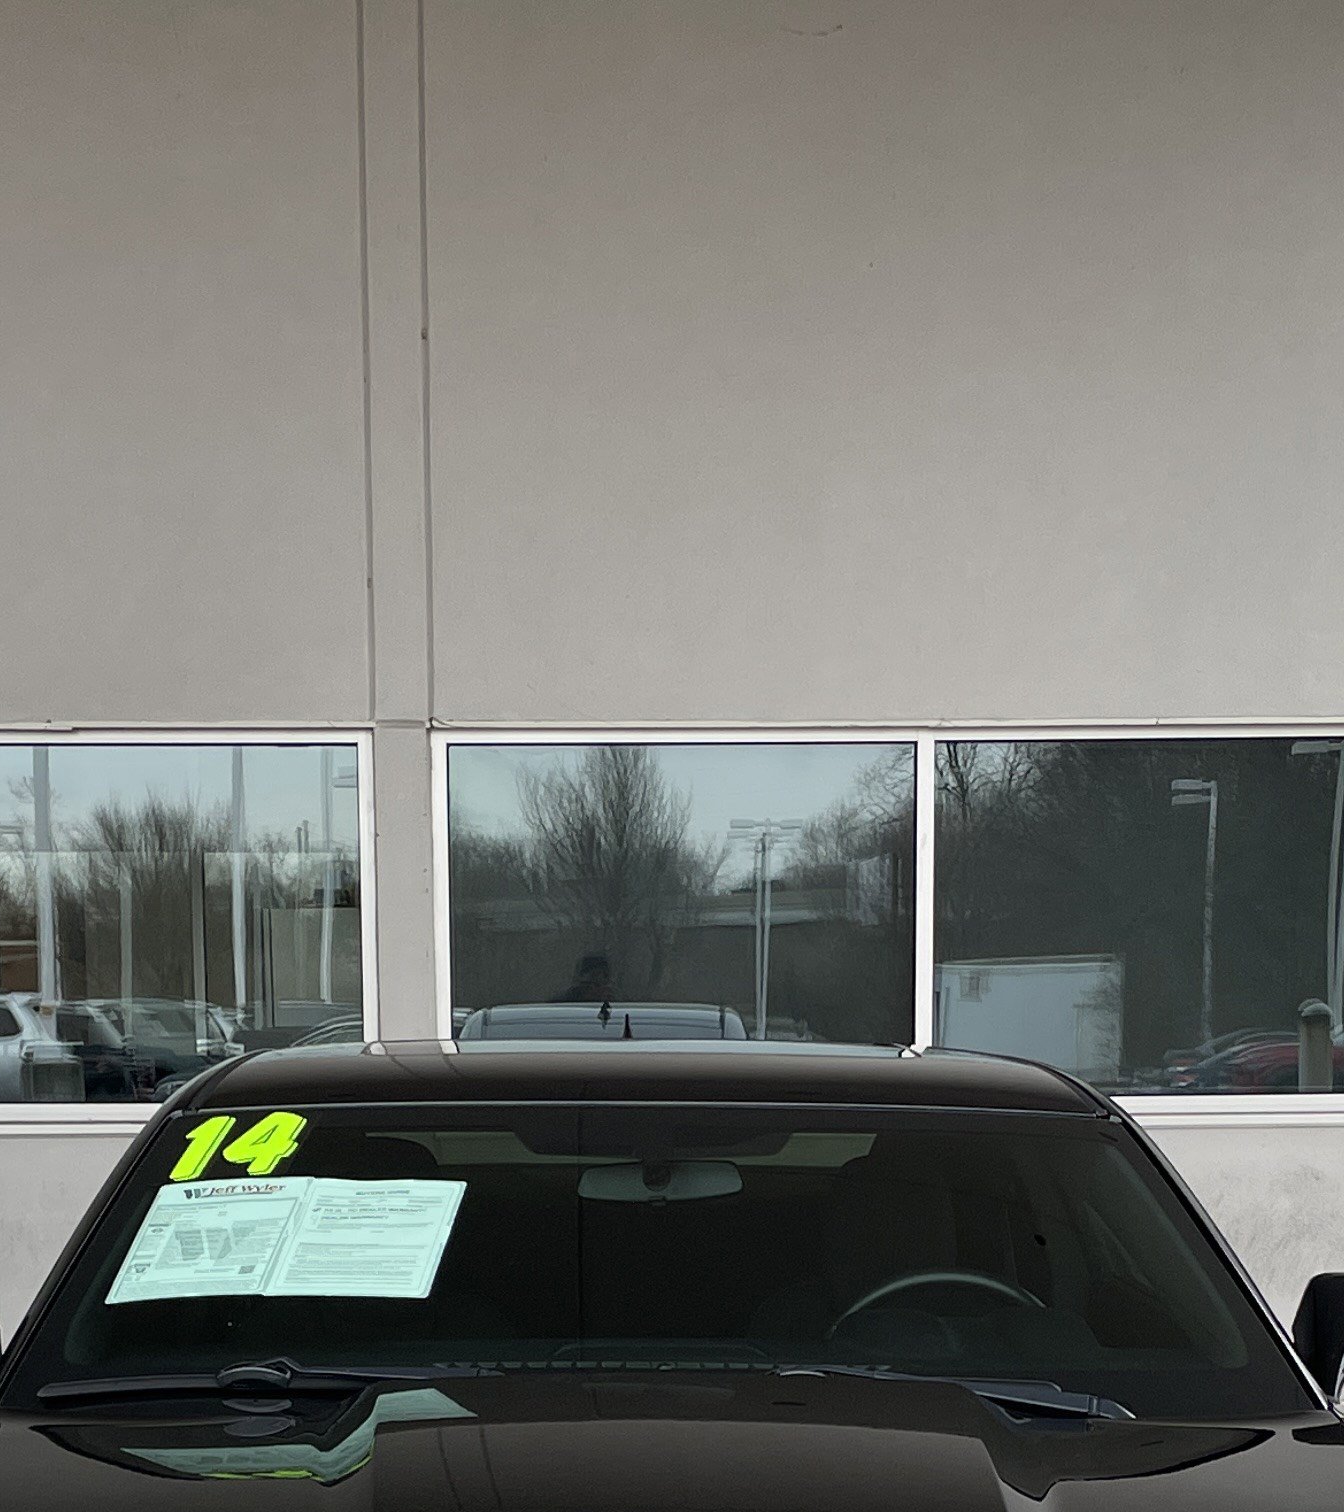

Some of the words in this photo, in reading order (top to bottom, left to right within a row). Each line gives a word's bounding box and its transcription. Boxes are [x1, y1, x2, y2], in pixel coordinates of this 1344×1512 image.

[169, 1111, 307, 1181] 14
[206, 1185, 239, 1197] Jeff
[242, 1183, 287, 1193] Wyler
